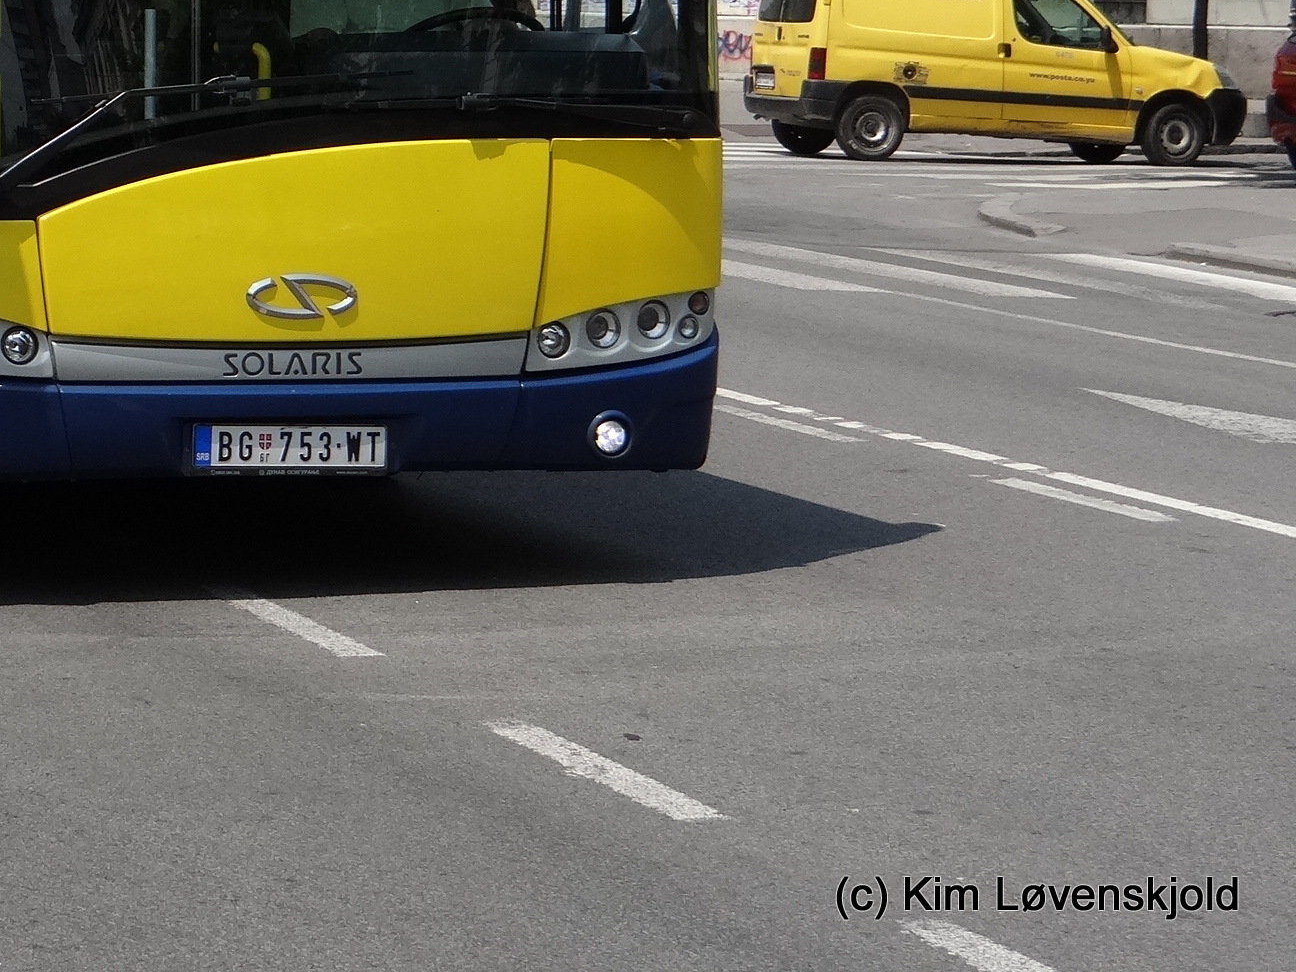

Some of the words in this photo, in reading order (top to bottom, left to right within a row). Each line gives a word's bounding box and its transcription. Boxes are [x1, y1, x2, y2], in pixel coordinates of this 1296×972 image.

[222, 351, 363, 377] SOLARIS
[196, 452, 210, 461] SRB
[217, 431, 253, 461] BG
